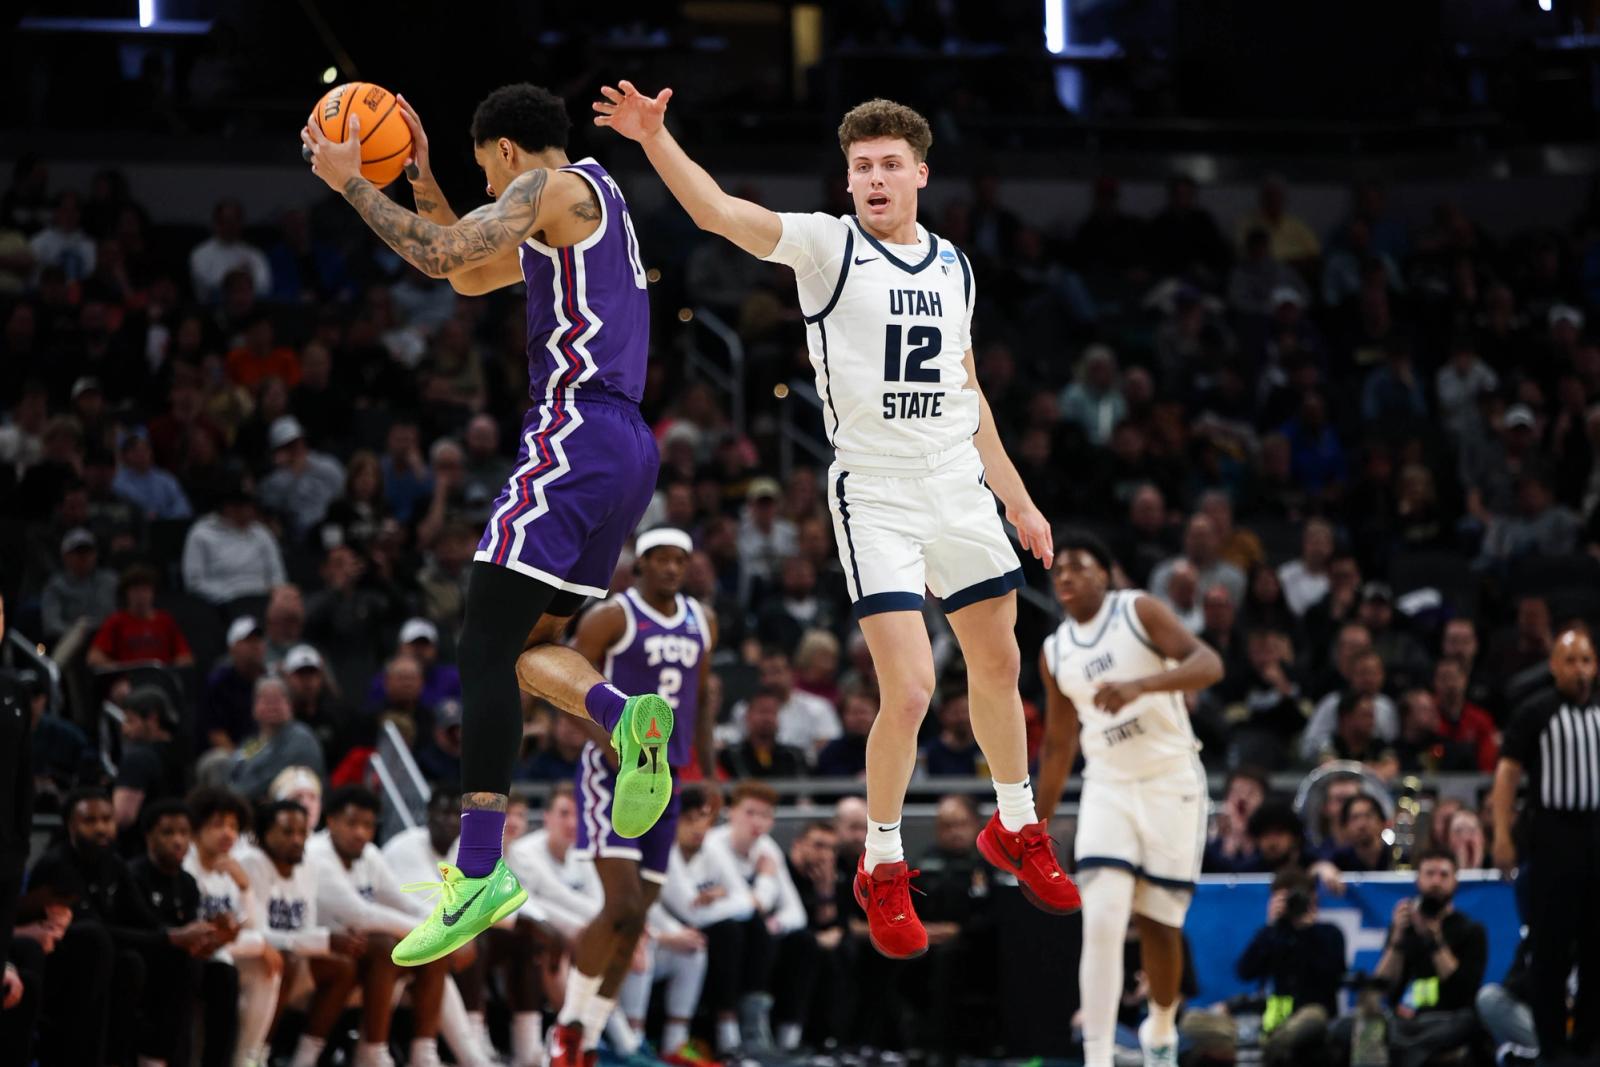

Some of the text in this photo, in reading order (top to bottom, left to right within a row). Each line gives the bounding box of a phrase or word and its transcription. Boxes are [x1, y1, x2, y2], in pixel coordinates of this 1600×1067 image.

[889, 289, 943, 318] UTAH
[884, 324, 942, 383] 12
[883, 392, 945, 419] STATE
[644, 634, 700, 668] TCU
[657, 667, 682, 708] 2
